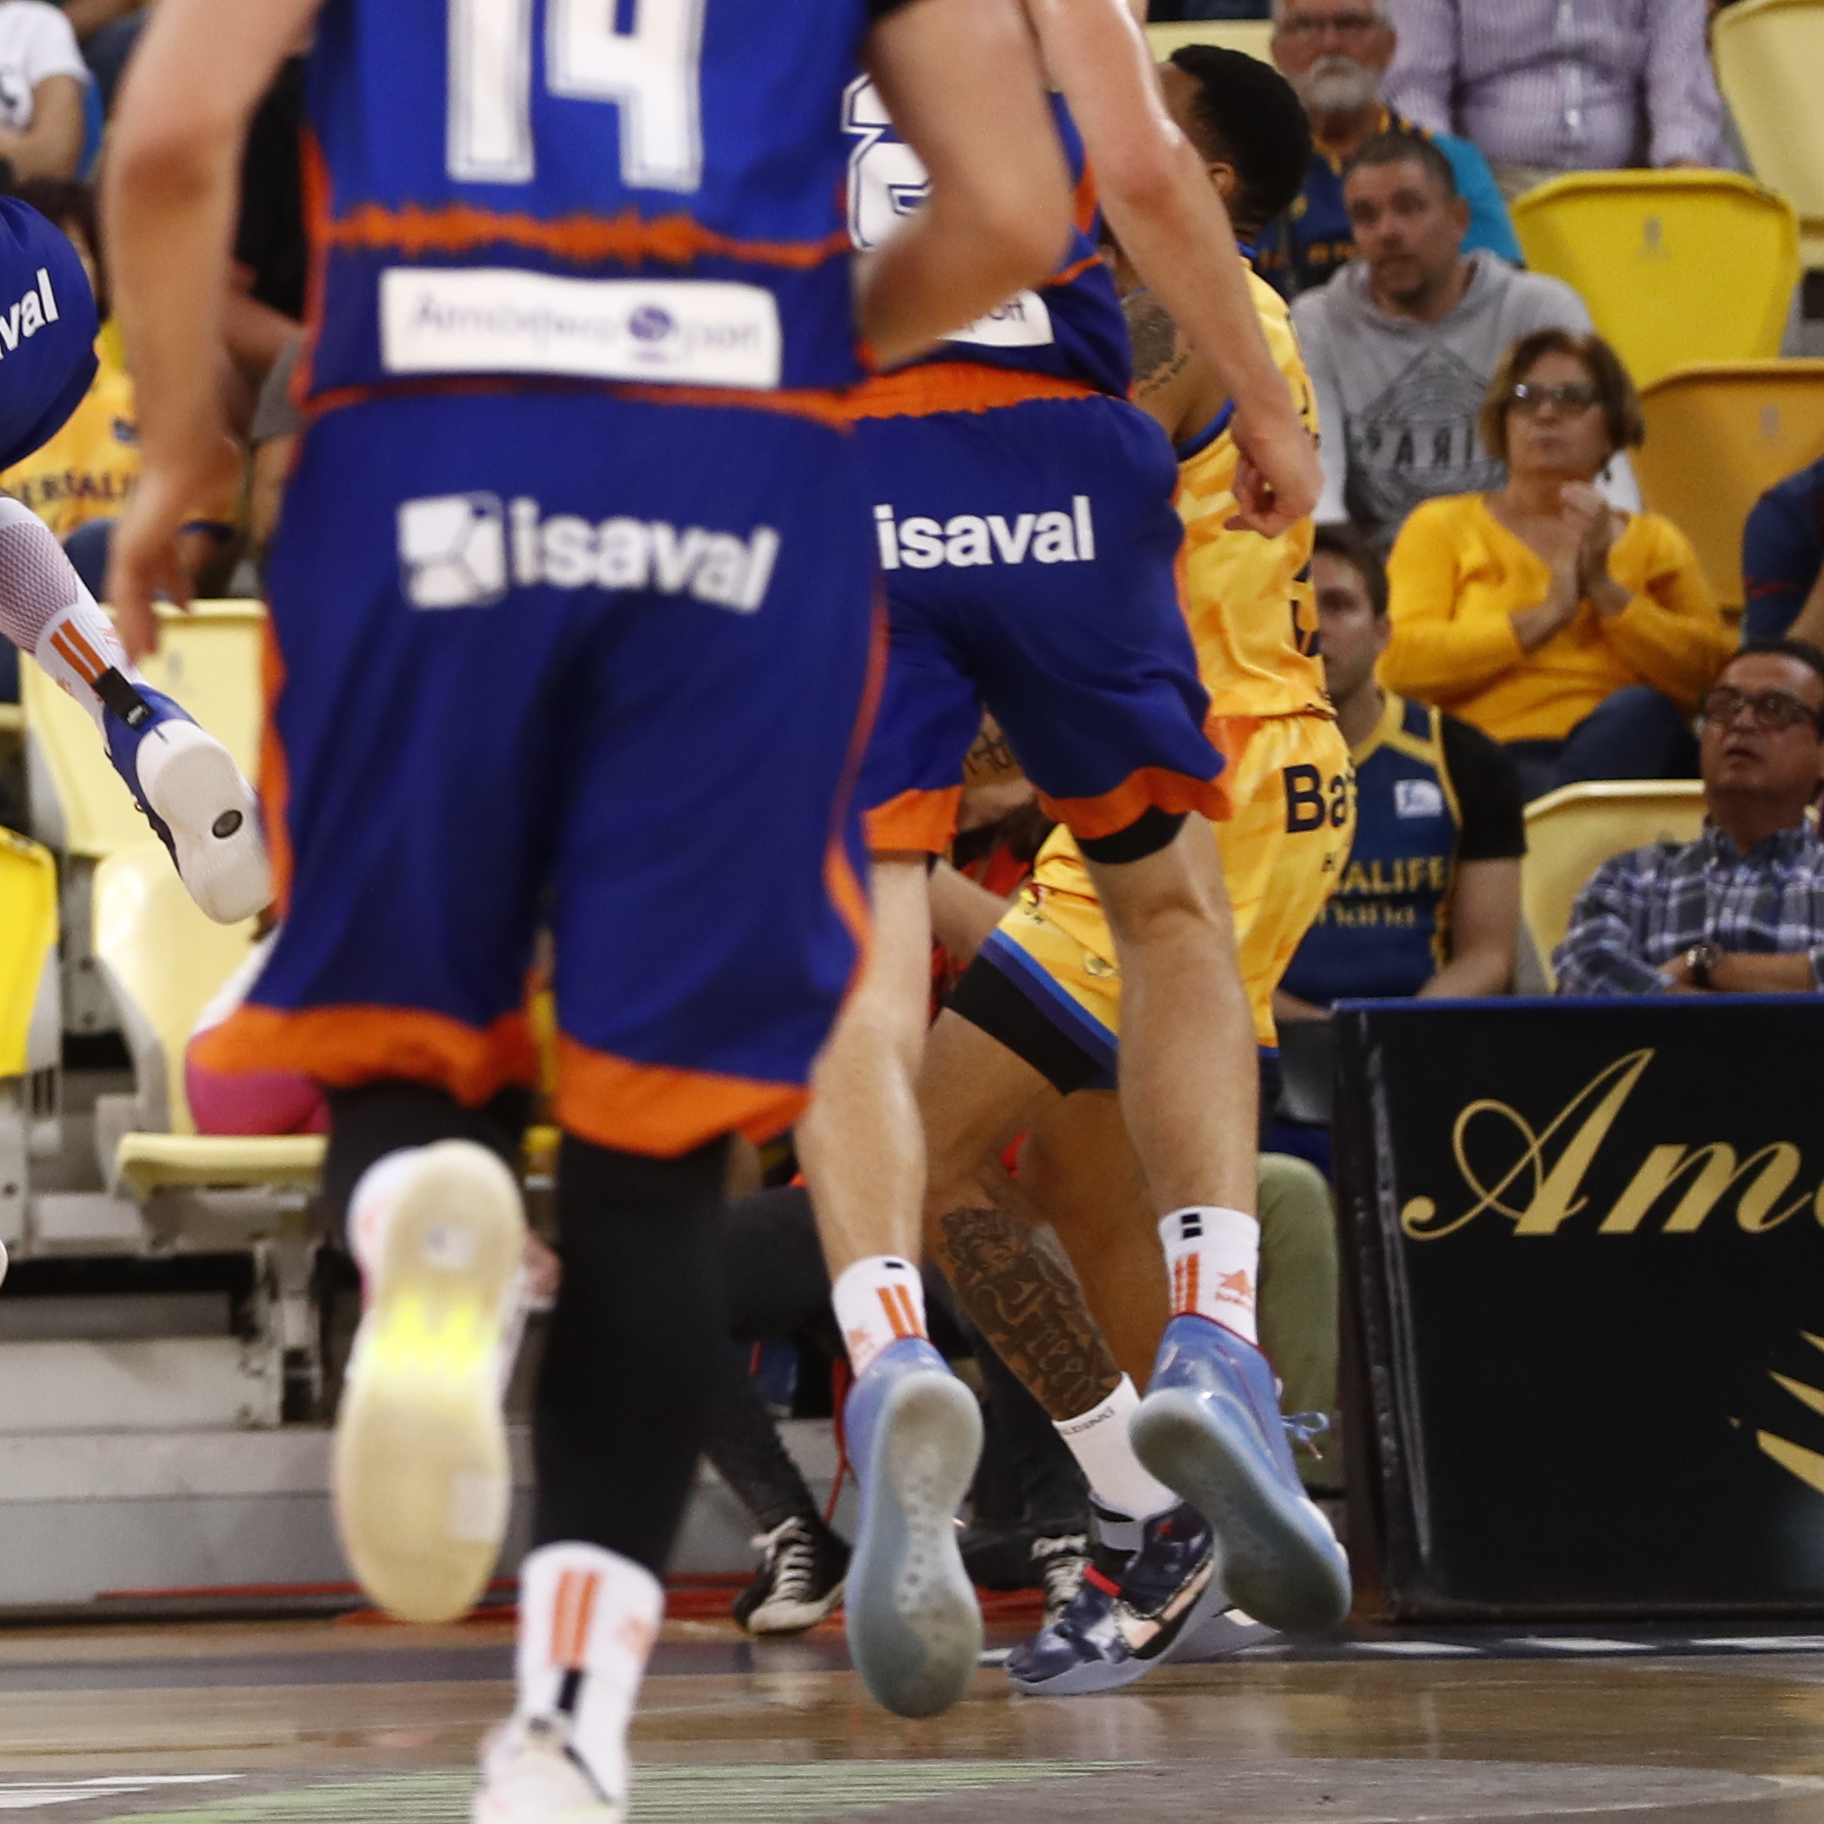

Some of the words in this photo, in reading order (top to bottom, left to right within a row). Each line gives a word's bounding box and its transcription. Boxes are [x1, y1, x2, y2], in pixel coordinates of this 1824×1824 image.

[509, 495, 780, 615] isaval
[873, 494, 1096, 571] isaval
[1283, 763, 1350, 834] Ba
[1401, 1047, 1824, 1241] Am
